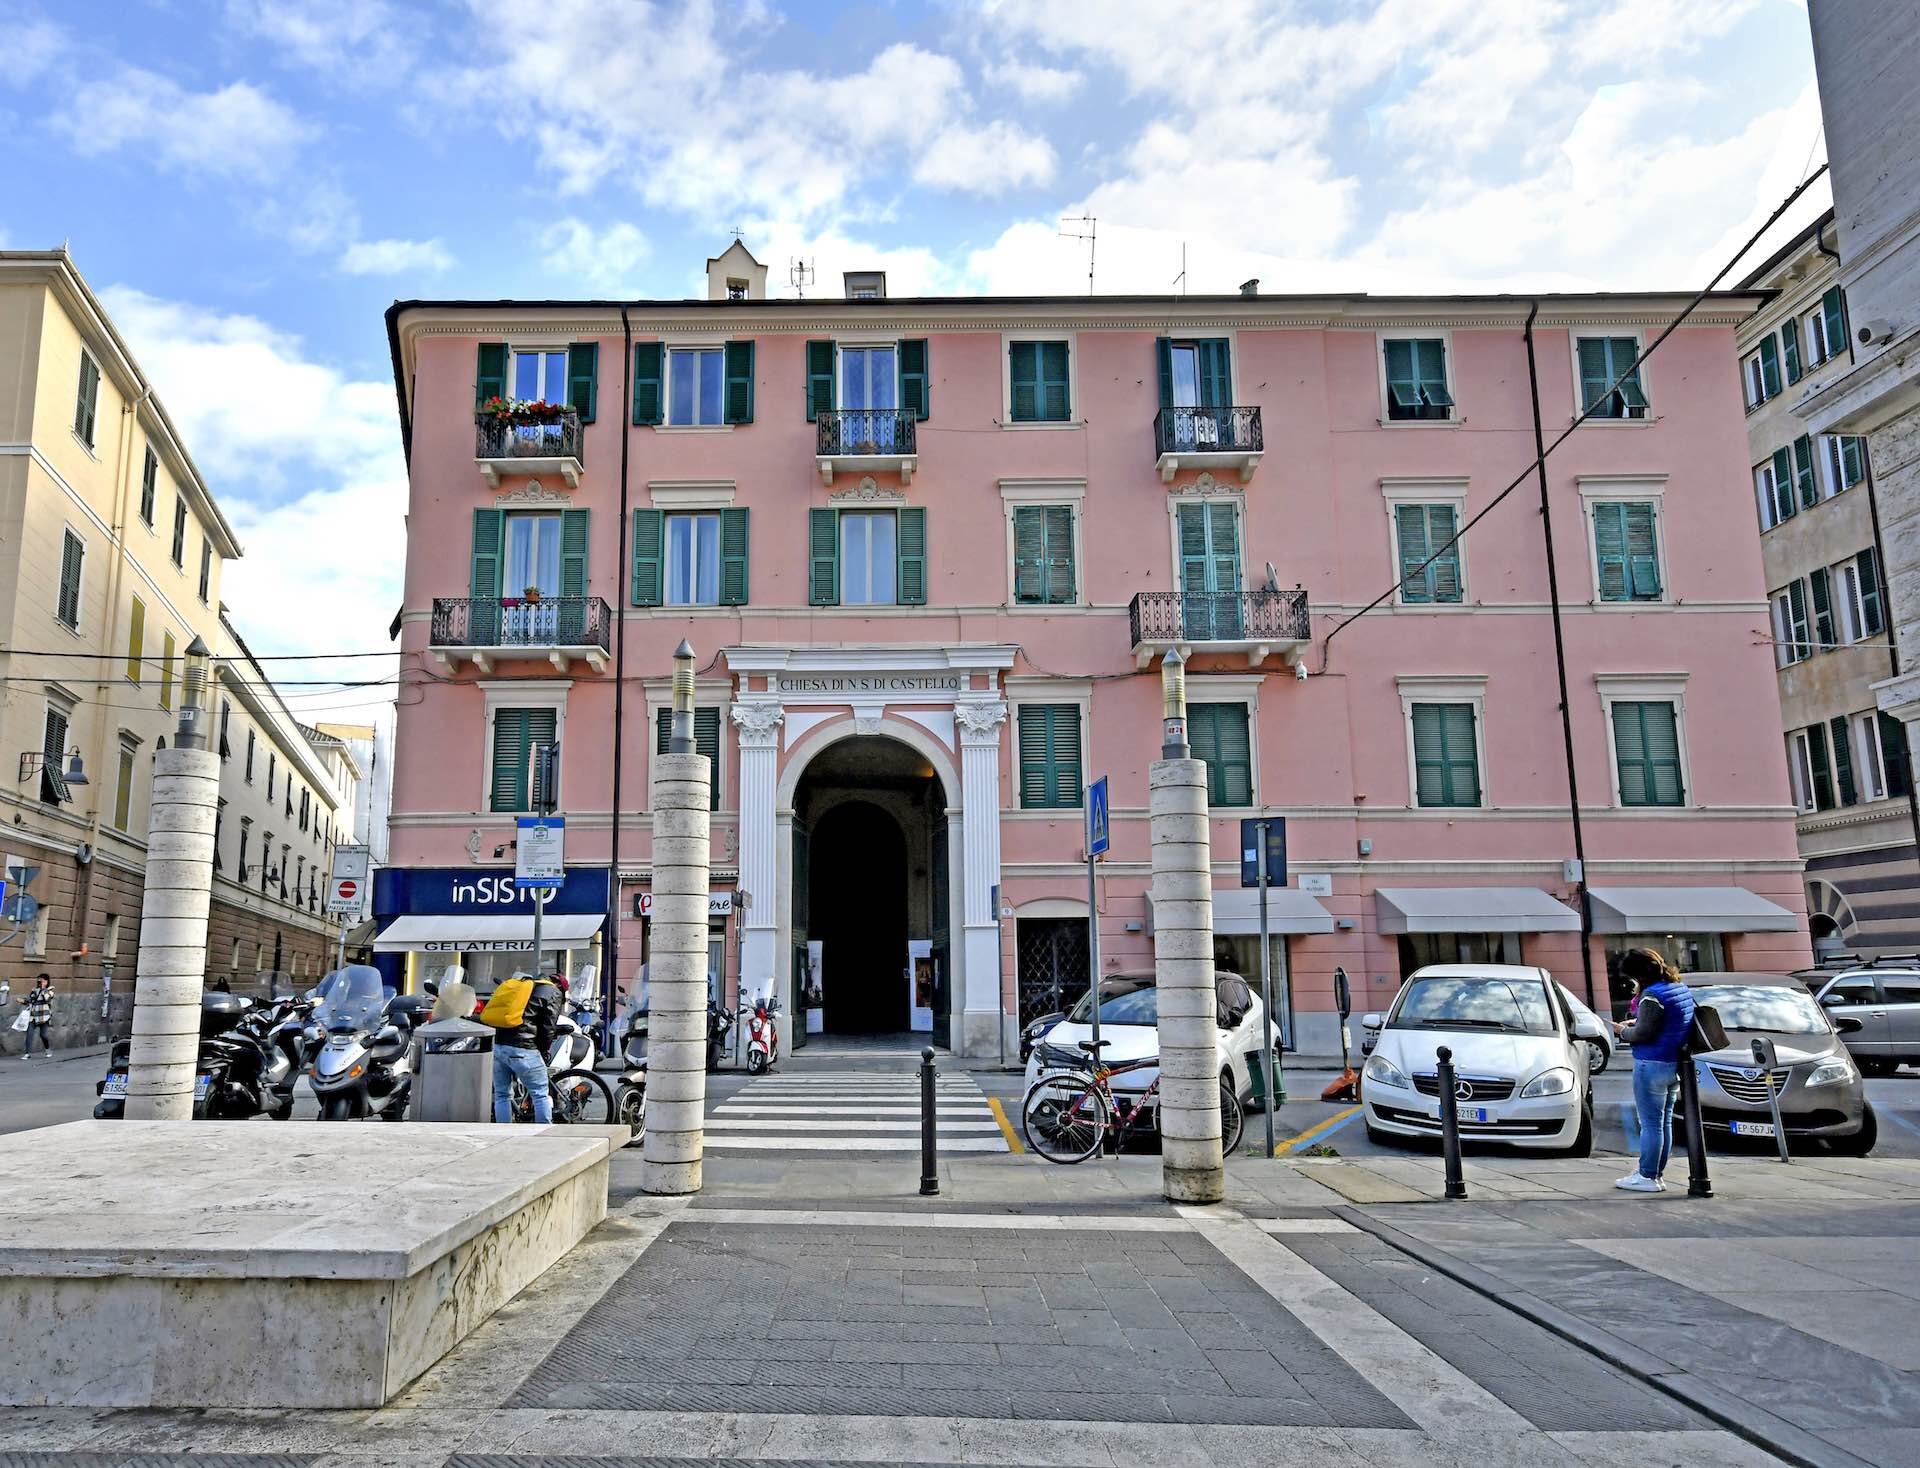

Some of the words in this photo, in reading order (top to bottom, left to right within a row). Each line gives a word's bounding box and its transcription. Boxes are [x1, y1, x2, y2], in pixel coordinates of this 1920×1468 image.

[780, 679, 827, 691] CHIESA
[832, 679, 844, 690] DI
[874, 679, 886, 690] DI
[890, 677, 958, 690] CASTELLO
[708, 899, 730, 910] ere
[424, 941, 535, 951] GELATERIA
